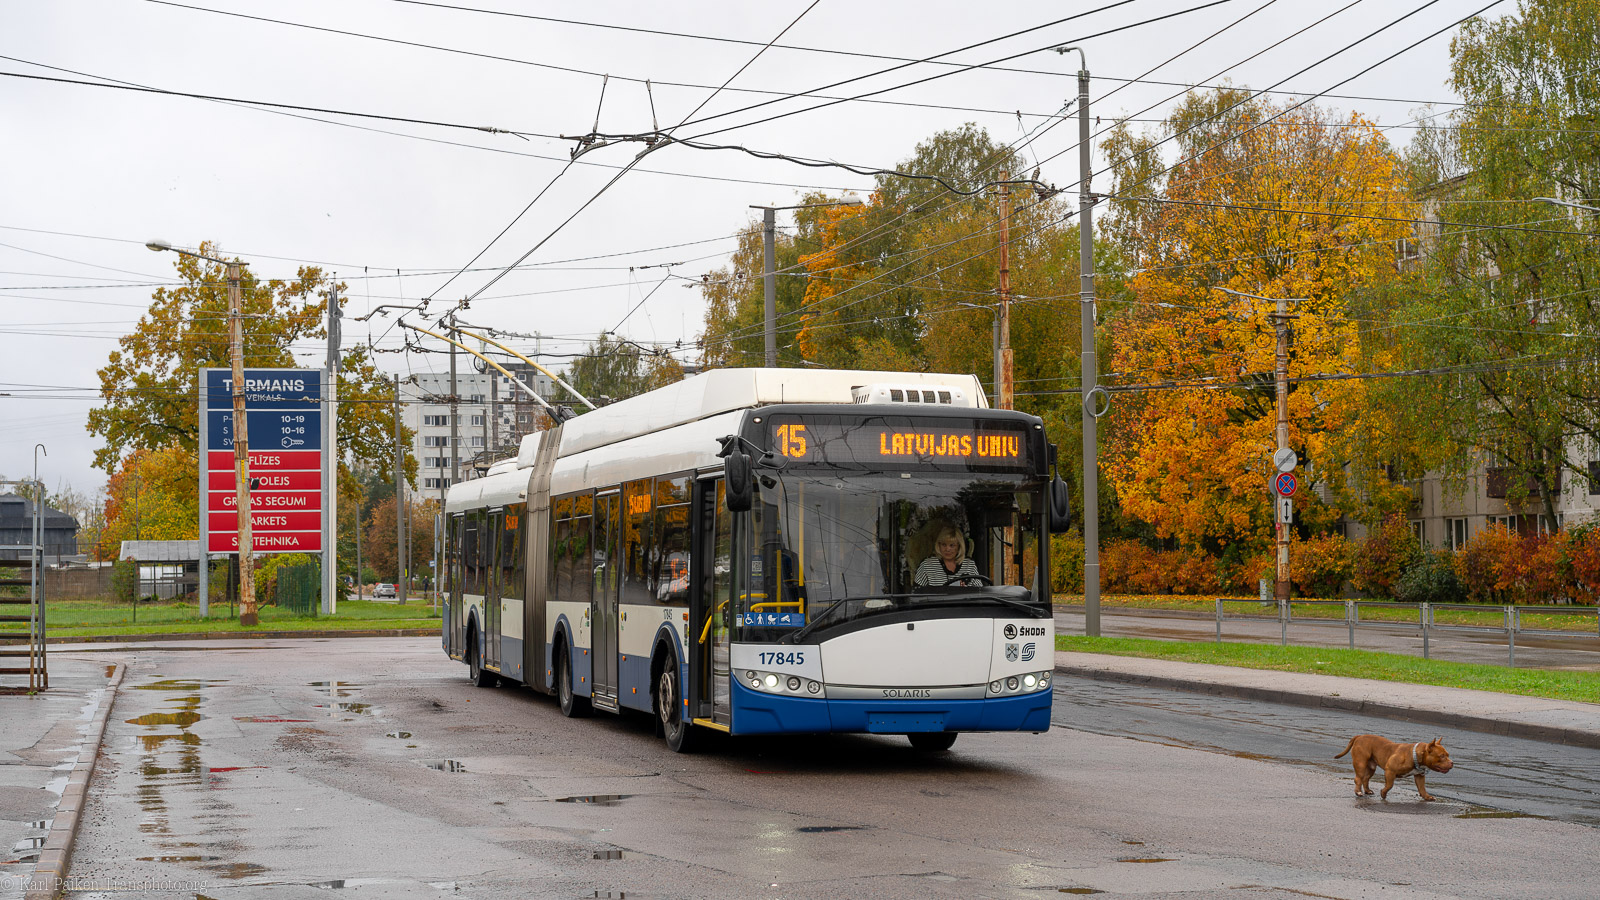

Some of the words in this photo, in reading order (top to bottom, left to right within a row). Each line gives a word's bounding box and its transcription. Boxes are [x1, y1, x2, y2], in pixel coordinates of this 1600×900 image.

[222, 379, 304, 392] TRMANS
[776, 424, 806, 458] 15
[880, 432, 972, 456] LATVIJAS
[978, 435, 1018, 457] UNIV
[249, 455, 280, 465] FLĪZES
[223, 497, 262, 506] GRAS
[265, 496, 306, 506] SEGUMI
[250, 516, 287, 525] ARKETS
[232, 537, 300, 546] STEHNIKA
[1020, 626, 1046, 636] ŠKODA
[758, 652, 804, 666] 17845
[882, 690, 931, 698] SOLARIS
